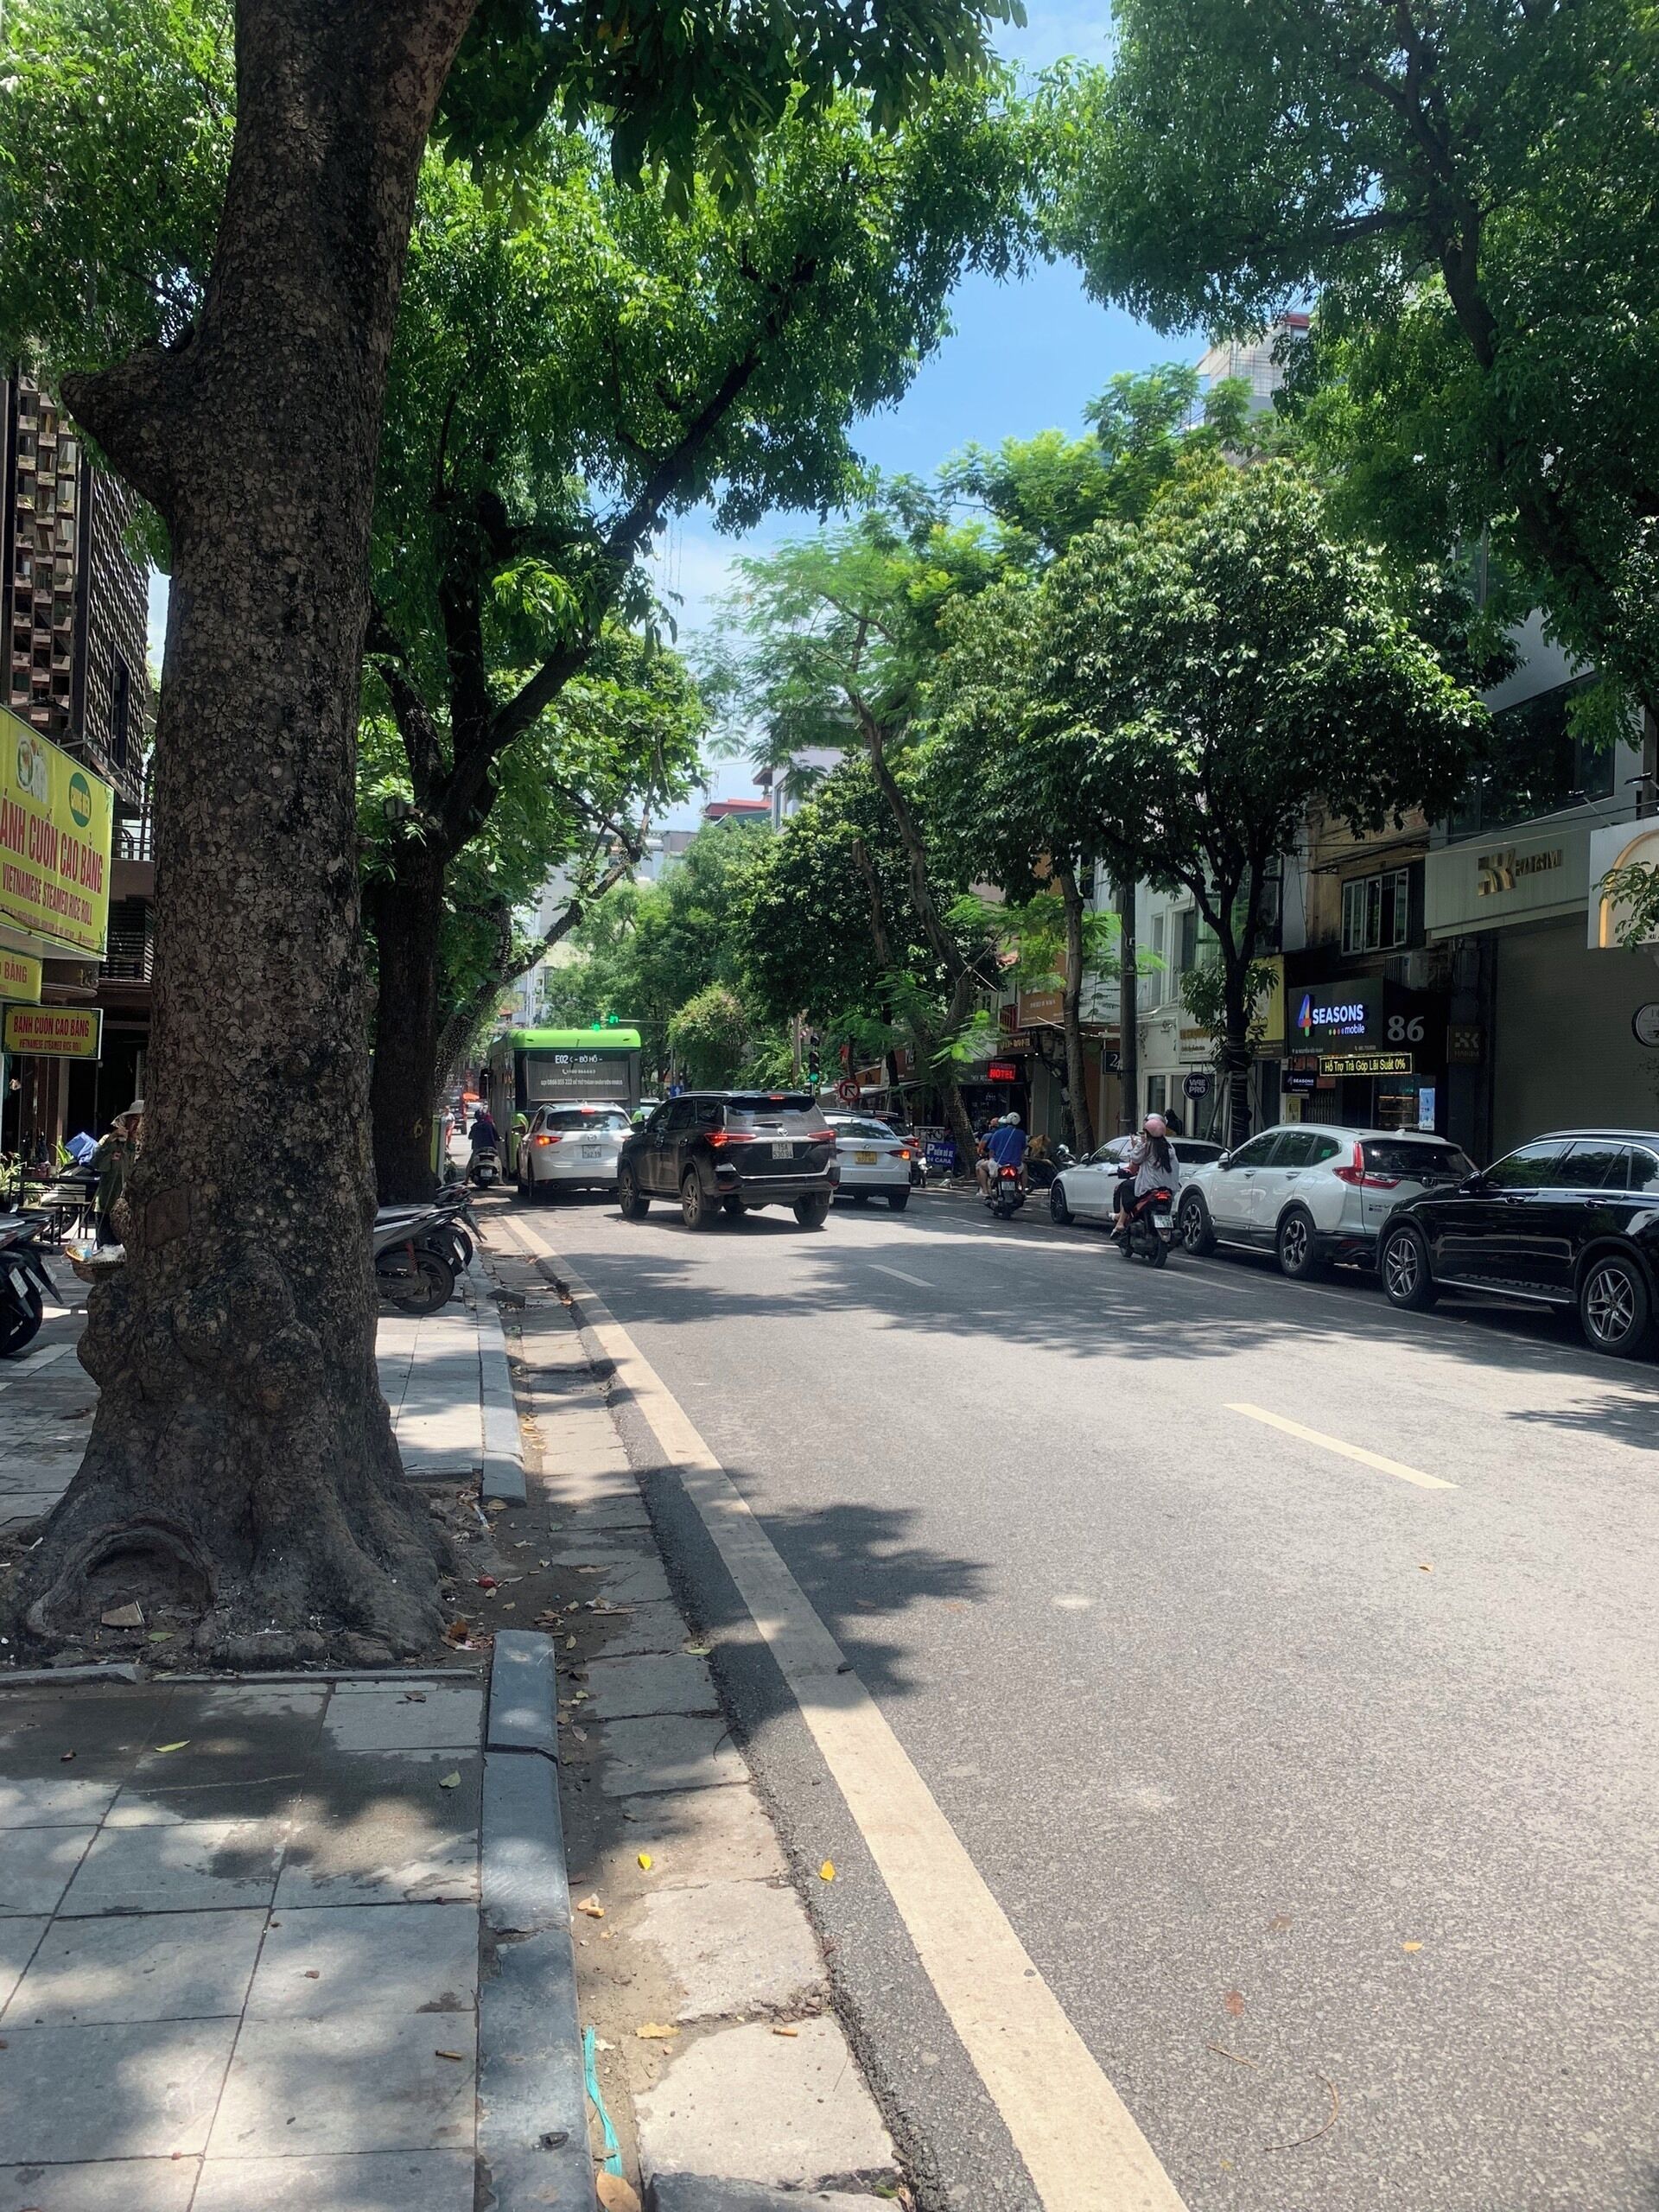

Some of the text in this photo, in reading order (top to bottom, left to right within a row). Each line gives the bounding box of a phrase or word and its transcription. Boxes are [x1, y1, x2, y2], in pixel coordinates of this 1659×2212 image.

[29, 808, 58, 872] CUỐN
[60, 832, 79, 882] CAO
[3, 861, 41, 906] VIETNAMESE
[42, 880, 68, 916] STEAMED
[68, 893, 80, 921] RICE
[81, 899, 92, 926] ROLL
[14, 1013, 33, 1033] BÁNH
[55, 1018, 69, 1036] CAO
[1313, 1003, 1364, 1026] SEASONS
[1344, 1023, 1365, 1035] mobile
[1388, 1015, 1425, 1042] 86
[555, 1054, 569, 1064] E02
[1356, 1059, 1368, 1072] Góp
[1395, 1058, 1406, 1070] 0%
[989, 1069, 1014, 1079] HOTEL
